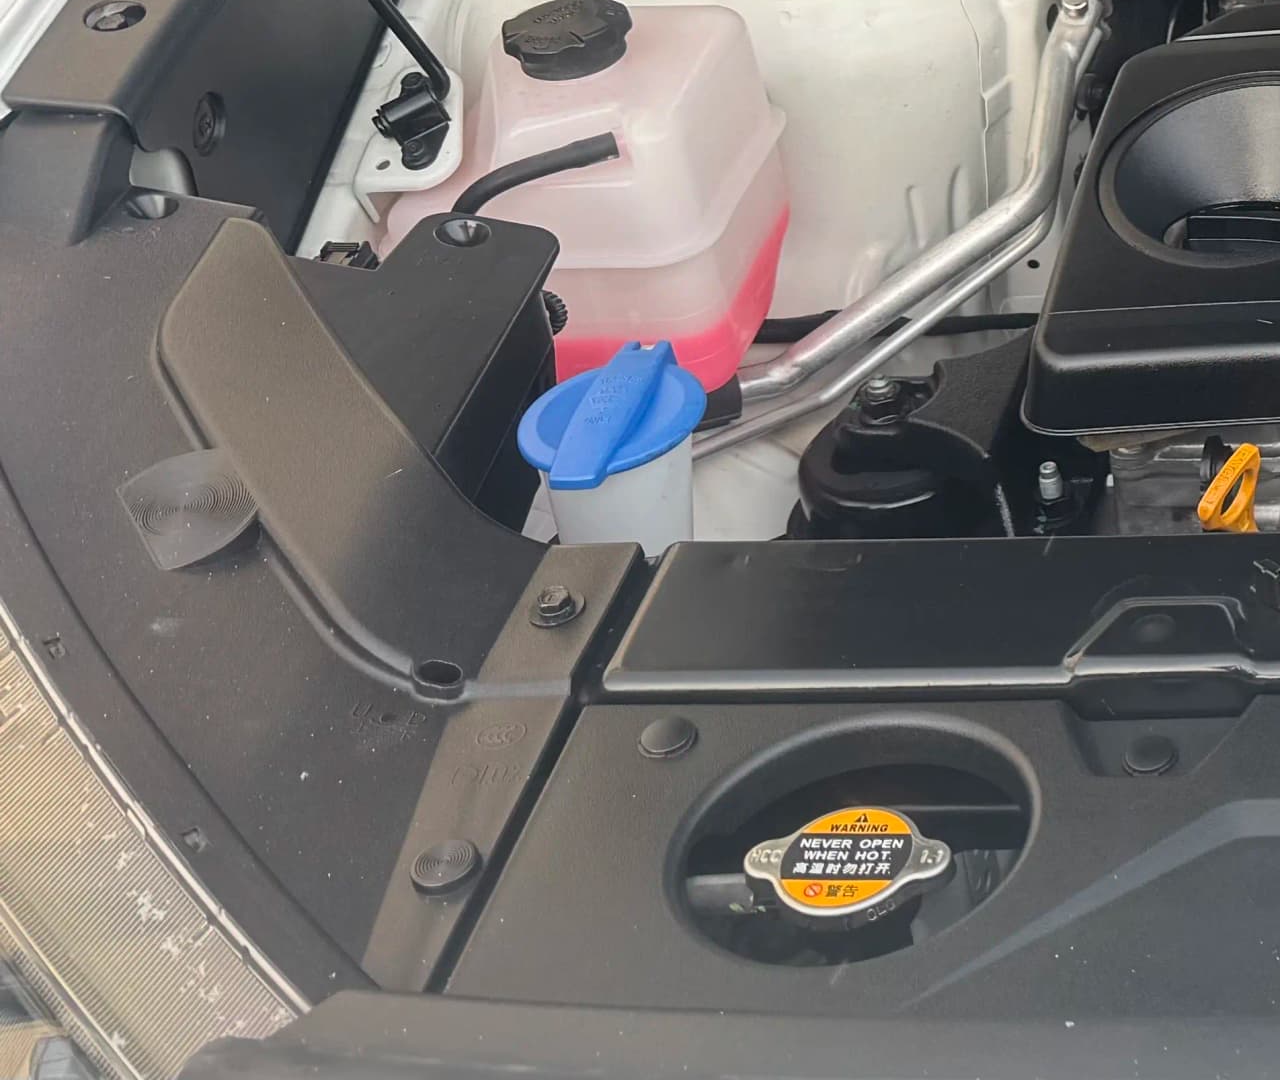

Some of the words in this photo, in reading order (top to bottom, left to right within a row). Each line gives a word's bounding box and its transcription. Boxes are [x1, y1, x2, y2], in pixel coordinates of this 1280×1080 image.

[830, 824, 888, 832] WARNING
[800, 838, 852, 849] NEVER
[859, 838, 904, 849] OPEN
[804, 850, 848, 861] WHEN
[855, 851, 892, 861] HOT.
